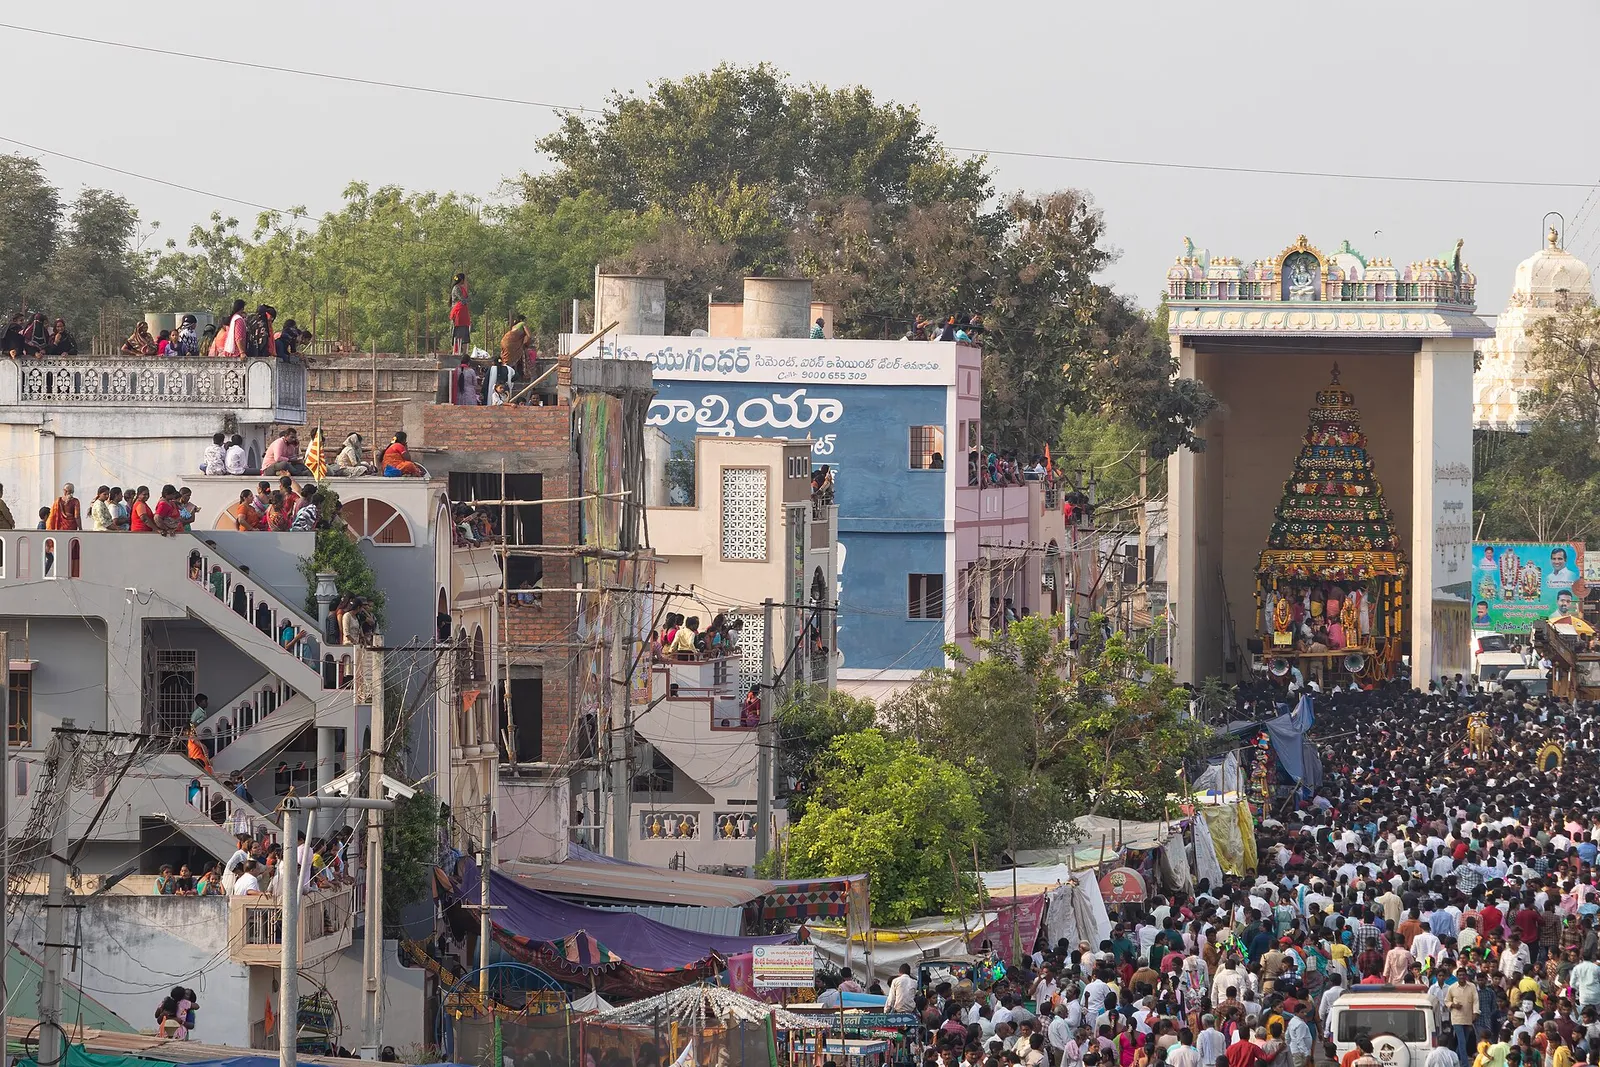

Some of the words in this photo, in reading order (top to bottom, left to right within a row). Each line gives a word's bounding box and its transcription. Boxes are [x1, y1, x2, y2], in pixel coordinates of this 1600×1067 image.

[801, 370, 827, 379] 9000
[828, 371, 847, 380] 655
[848, 371, 868, 380] 309
